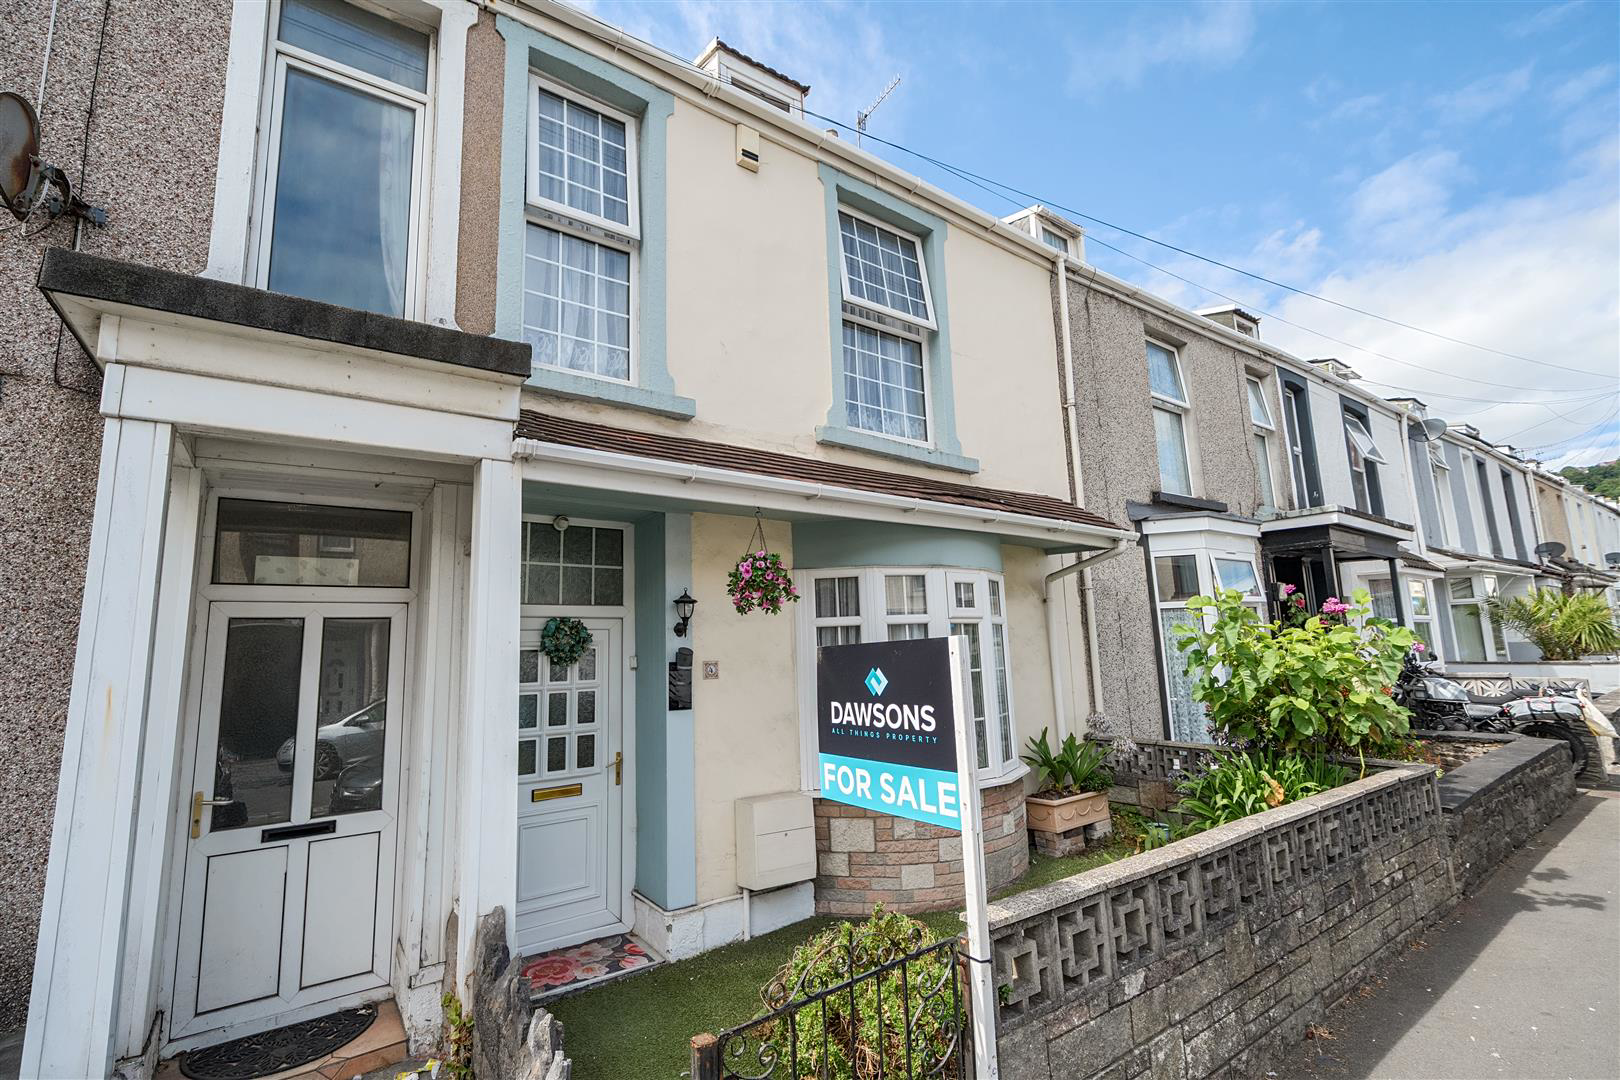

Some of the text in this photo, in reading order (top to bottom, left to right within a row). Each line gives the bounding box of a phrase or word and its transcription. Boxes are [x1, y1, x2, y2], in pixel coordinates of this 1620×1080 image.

[830, 701, 937, 732] DAWSONS
[831, 727, 937, 744] ALL THINGS PROPERTY
[823, 762, 959, 818] FOR SALE
